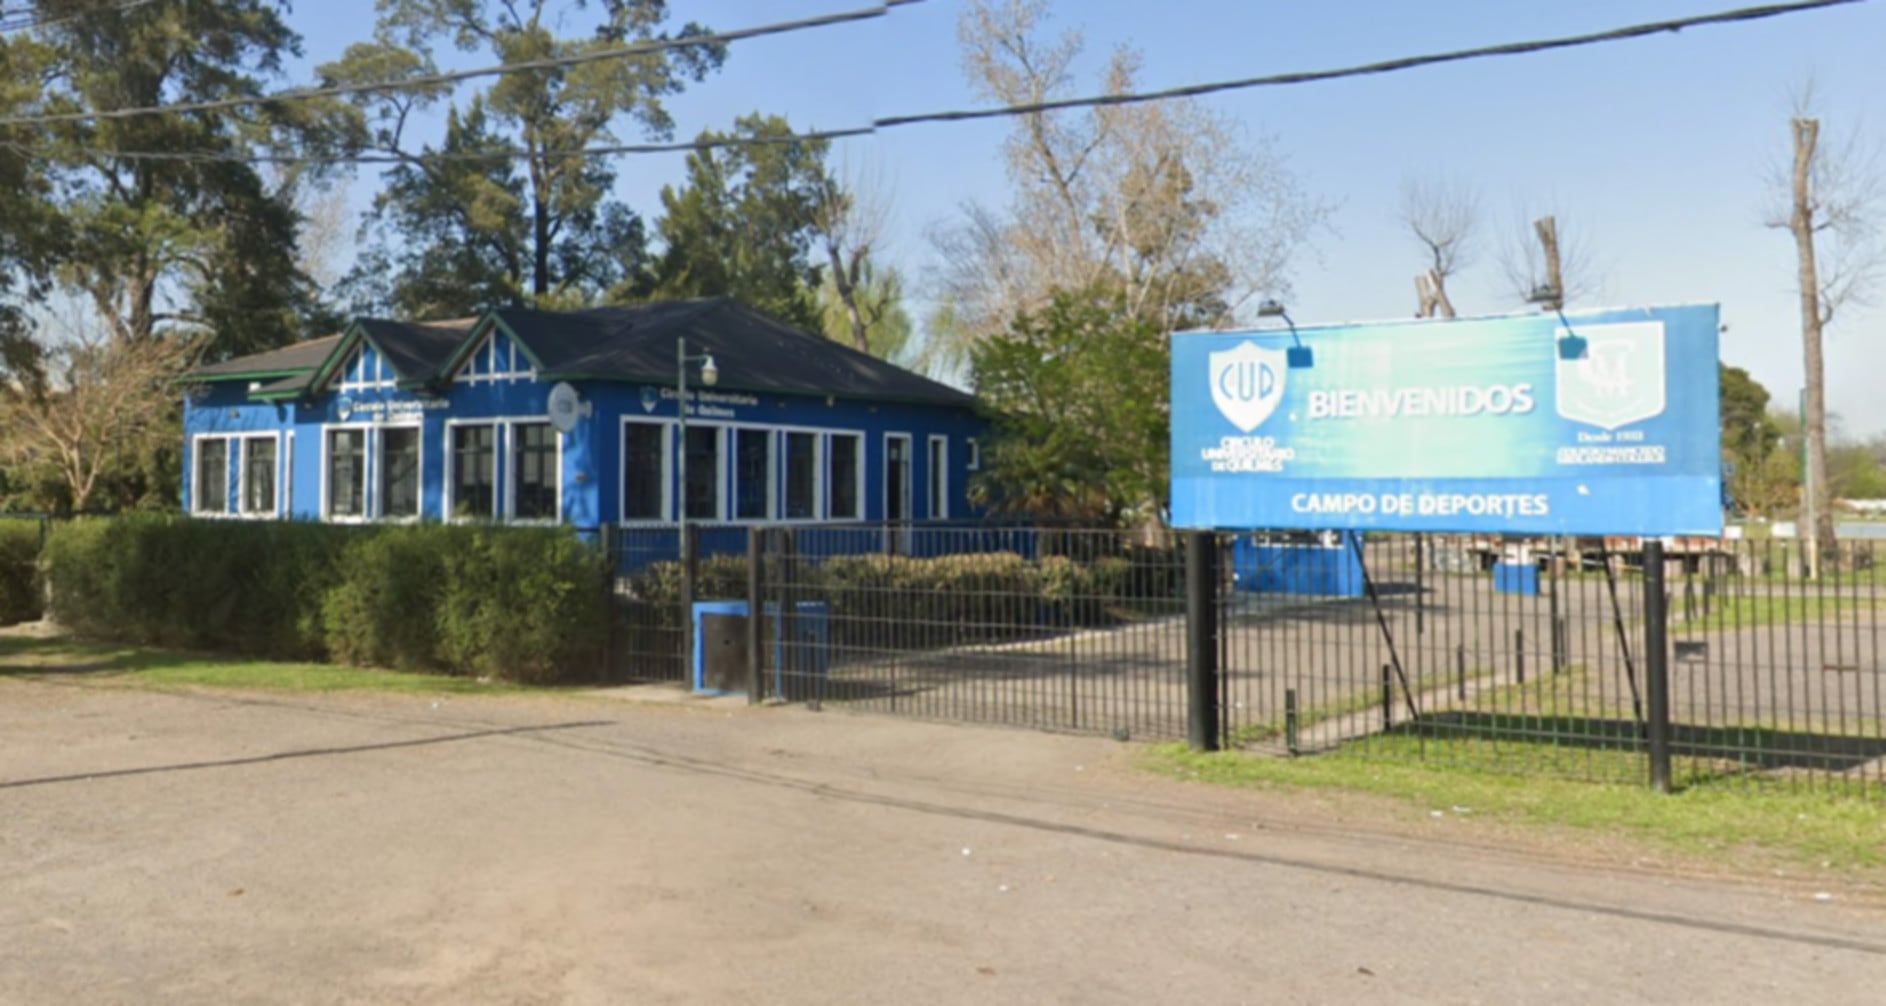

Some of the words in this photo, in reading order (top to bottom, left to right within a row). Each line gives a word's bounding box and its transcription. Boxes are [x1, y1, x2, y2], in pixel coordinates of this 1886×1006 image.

[1307, 383, 1535, 419] BIENVENIDOS
[1291, 493, 1376, 514] CAMPO
[1381, 494, 1415, 516] DE
[1418, 494, 1550, 518] DEPORTES
